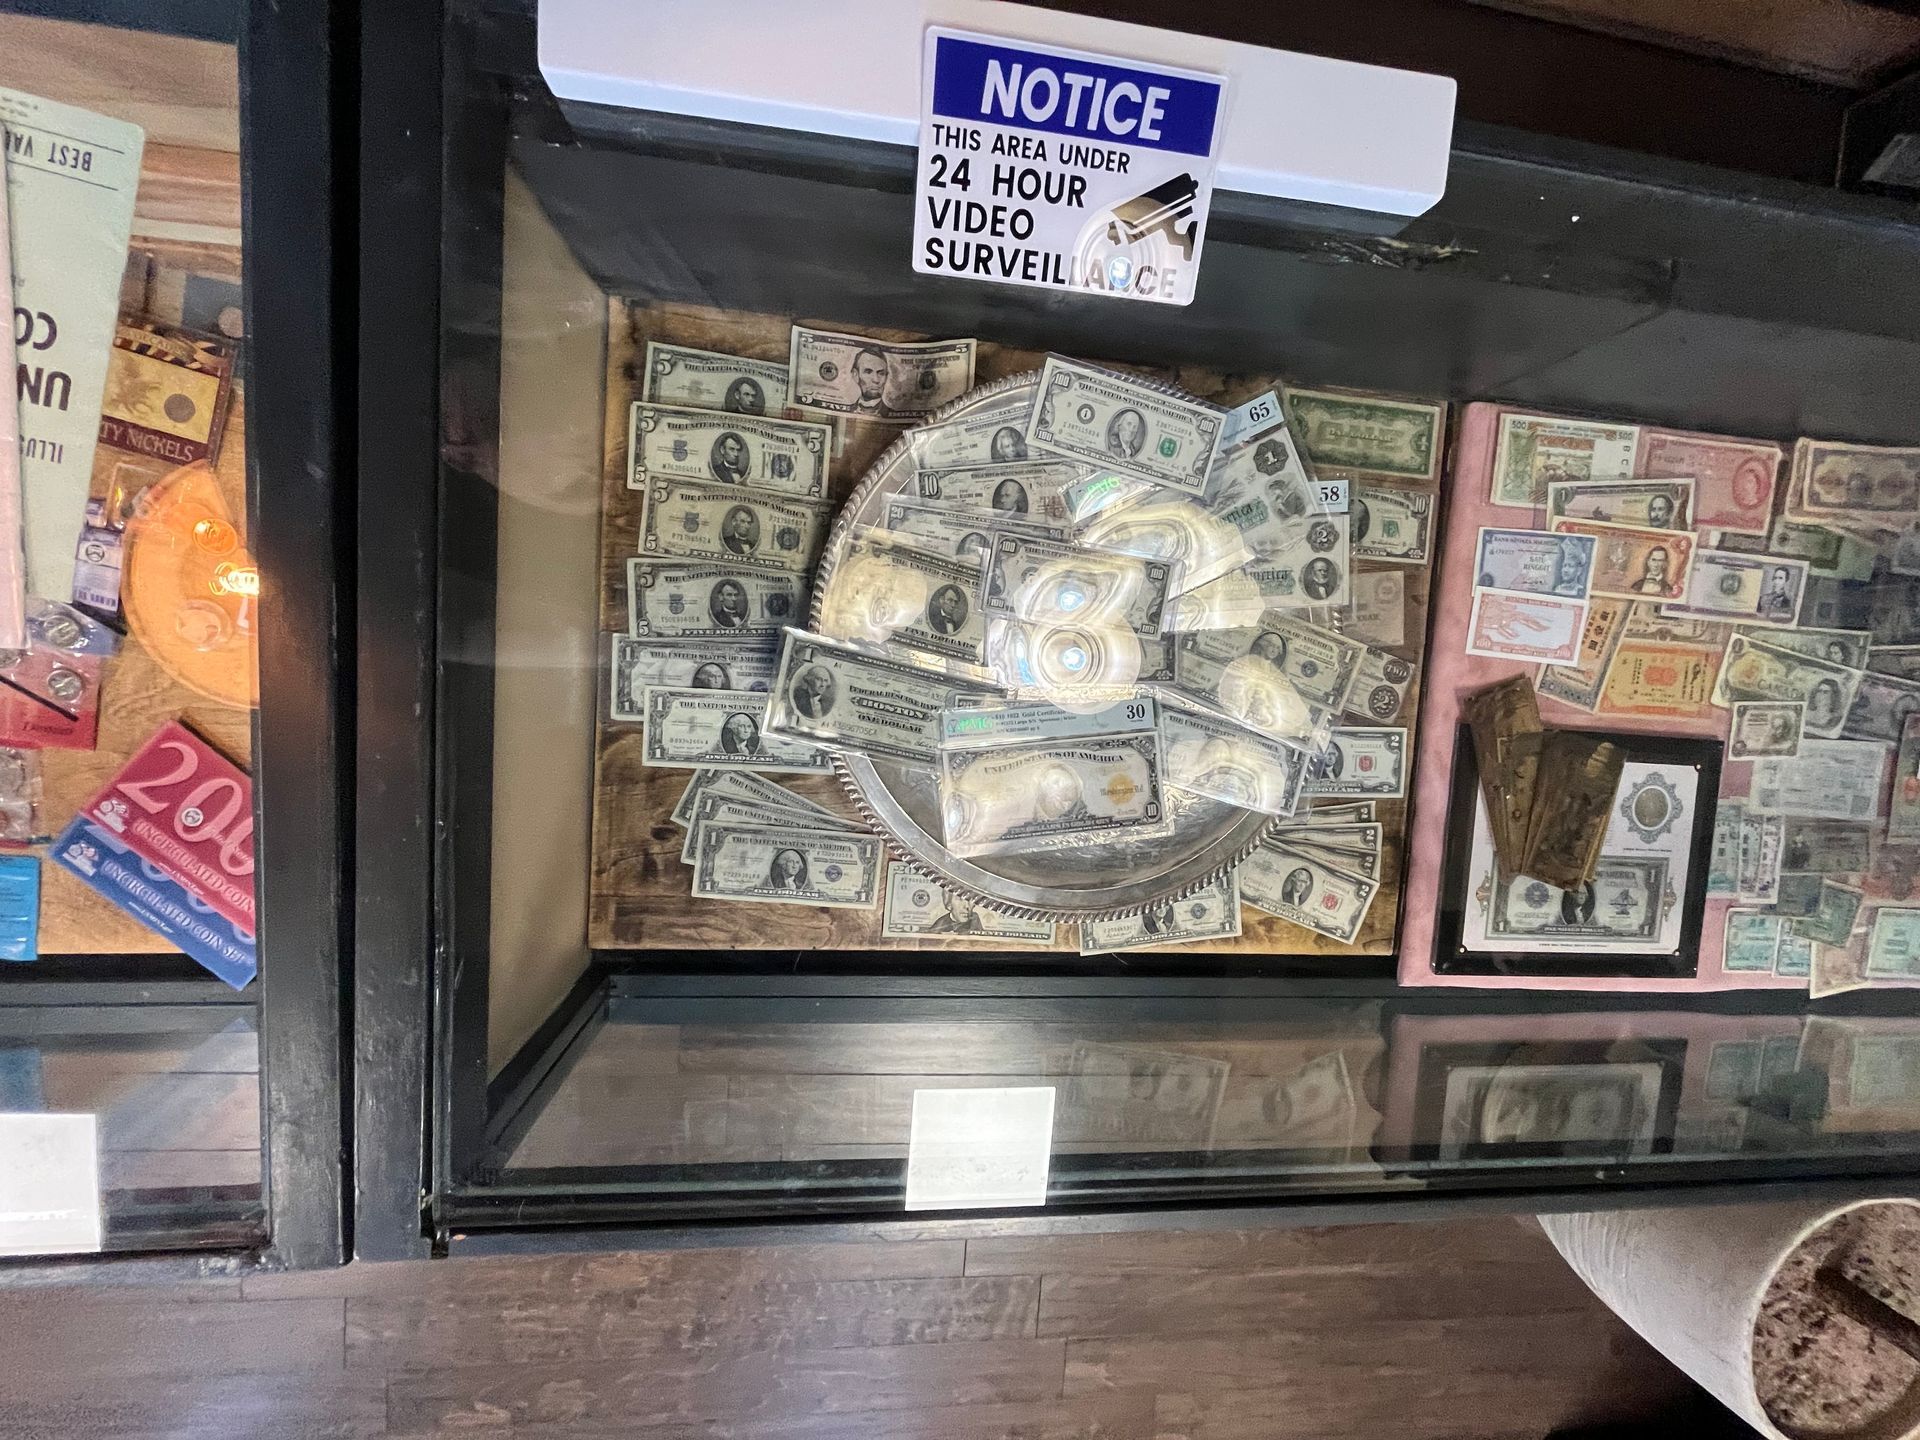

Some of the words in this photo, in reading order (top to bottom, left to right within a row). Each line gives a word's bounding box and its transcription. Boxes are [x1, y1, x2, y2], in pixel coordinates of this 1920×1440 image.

[981, 59, 1171, 141] NOTICE
[48, 142, 92, 172] BEST
[932, 124, 981, 151] THIS
[991, 133, 1047, 162] AREA
[1059, 144, 1130, 174] UNDER
[929, 155, 971, 191] 24
[992, 164, 1087, 208] HOUR
[928, 196, 1034, 240] VIDEO
[656, 352, 672, 375] 5
[1054, 373, 1071, 388] 100
[641, 409, 656, 432] 5
[1249, 401, 1270, 422] 65
[1511, 420, 1527, 430] 500
[126, 428, 194, 462] NICKELS
[808, 431, 821, 453] 5
[1264, 451, 1278, 465] 1
[635, 465, 646, 482] 5
[654, 480, 669, 502] 5
[924, 473, 939, 496] 10
[1319, 485, 1340, 502] 58
[890, 505, 904, 519] 20
[645, 535, 657, 550] 5
[1318, 528, 1328, 543] 2
[637, 619, 649, 637] 5
[1126, 704, 1146, 719] 30
[1391, 735, 1399, 746] 2
